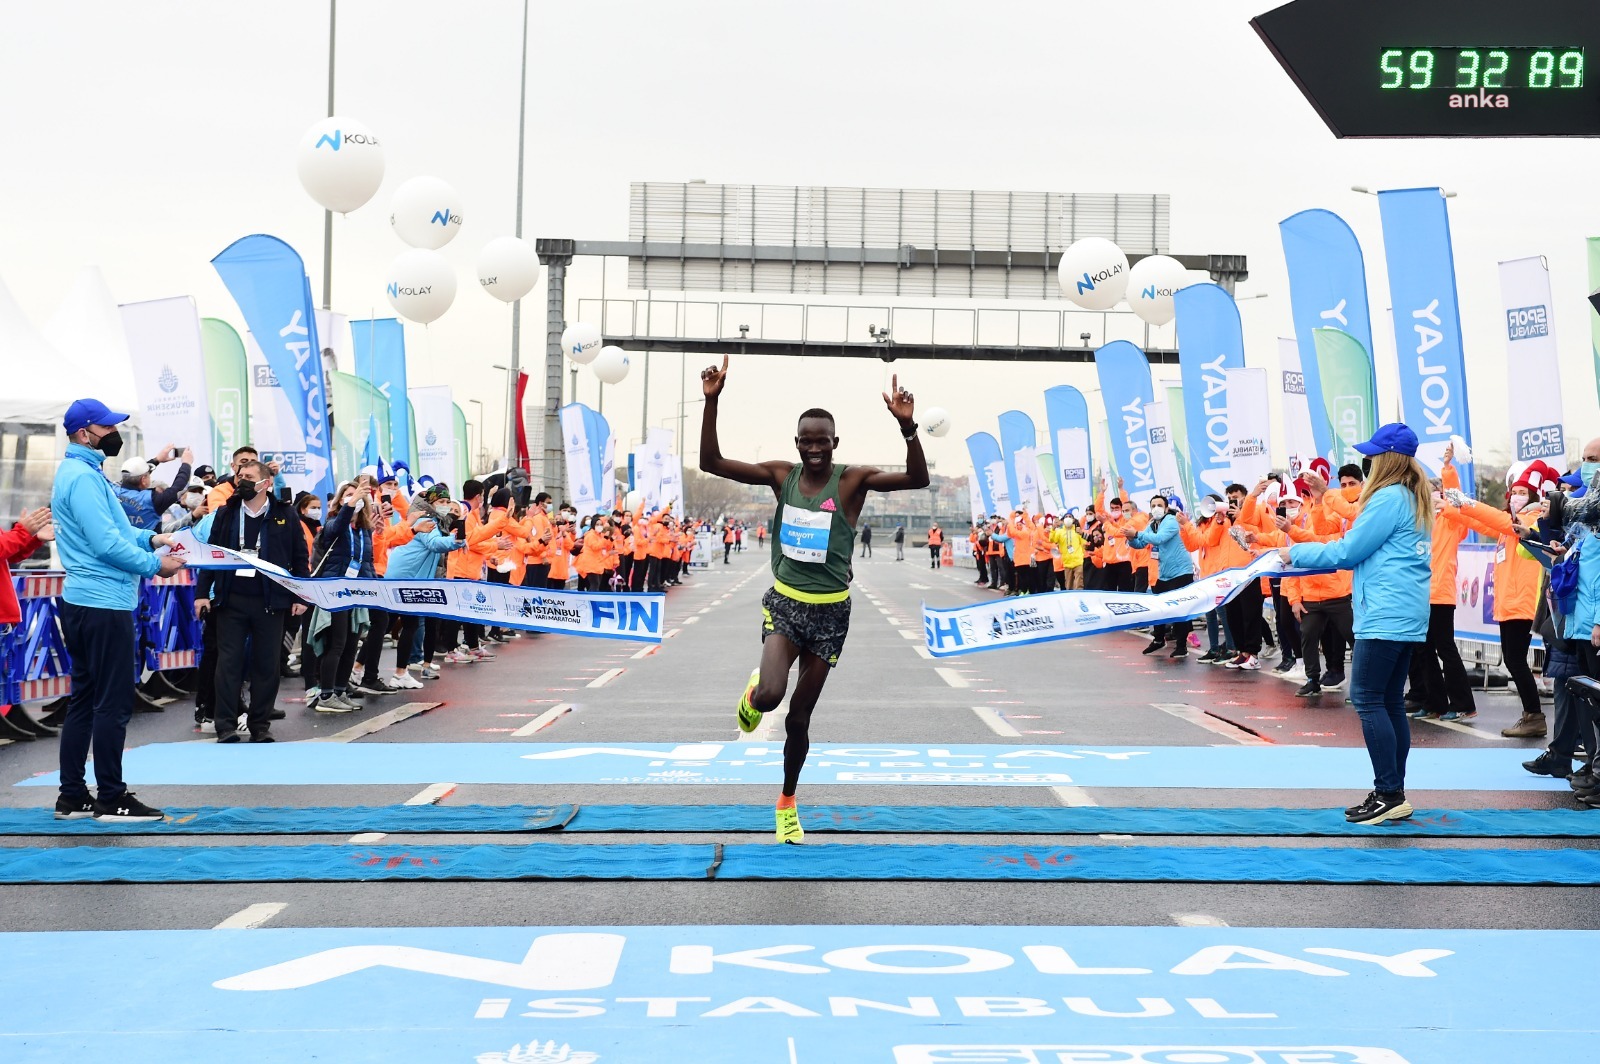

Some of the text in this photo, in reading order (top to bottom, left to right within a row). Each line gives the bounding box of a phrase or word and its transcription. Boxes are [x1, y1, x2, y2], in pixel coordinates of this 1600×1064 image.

[1380, 50, 1584, 89] 59 32 89
[1449, 88, 1509, 108] anka
[1091, 262, 1124, 283] KOLAY
[398, 286, 432, 296] KOLAY
[402, 589, 443, 598] SPOR
[542, 598, 566, 606] KOLAY
[548, 615, 581, 624] MARATONU
[590, 600, 659, 633] FIN
[744, 747, 1152, 760] KOLAY
[669, 944, 1457, 978] KOLAY
